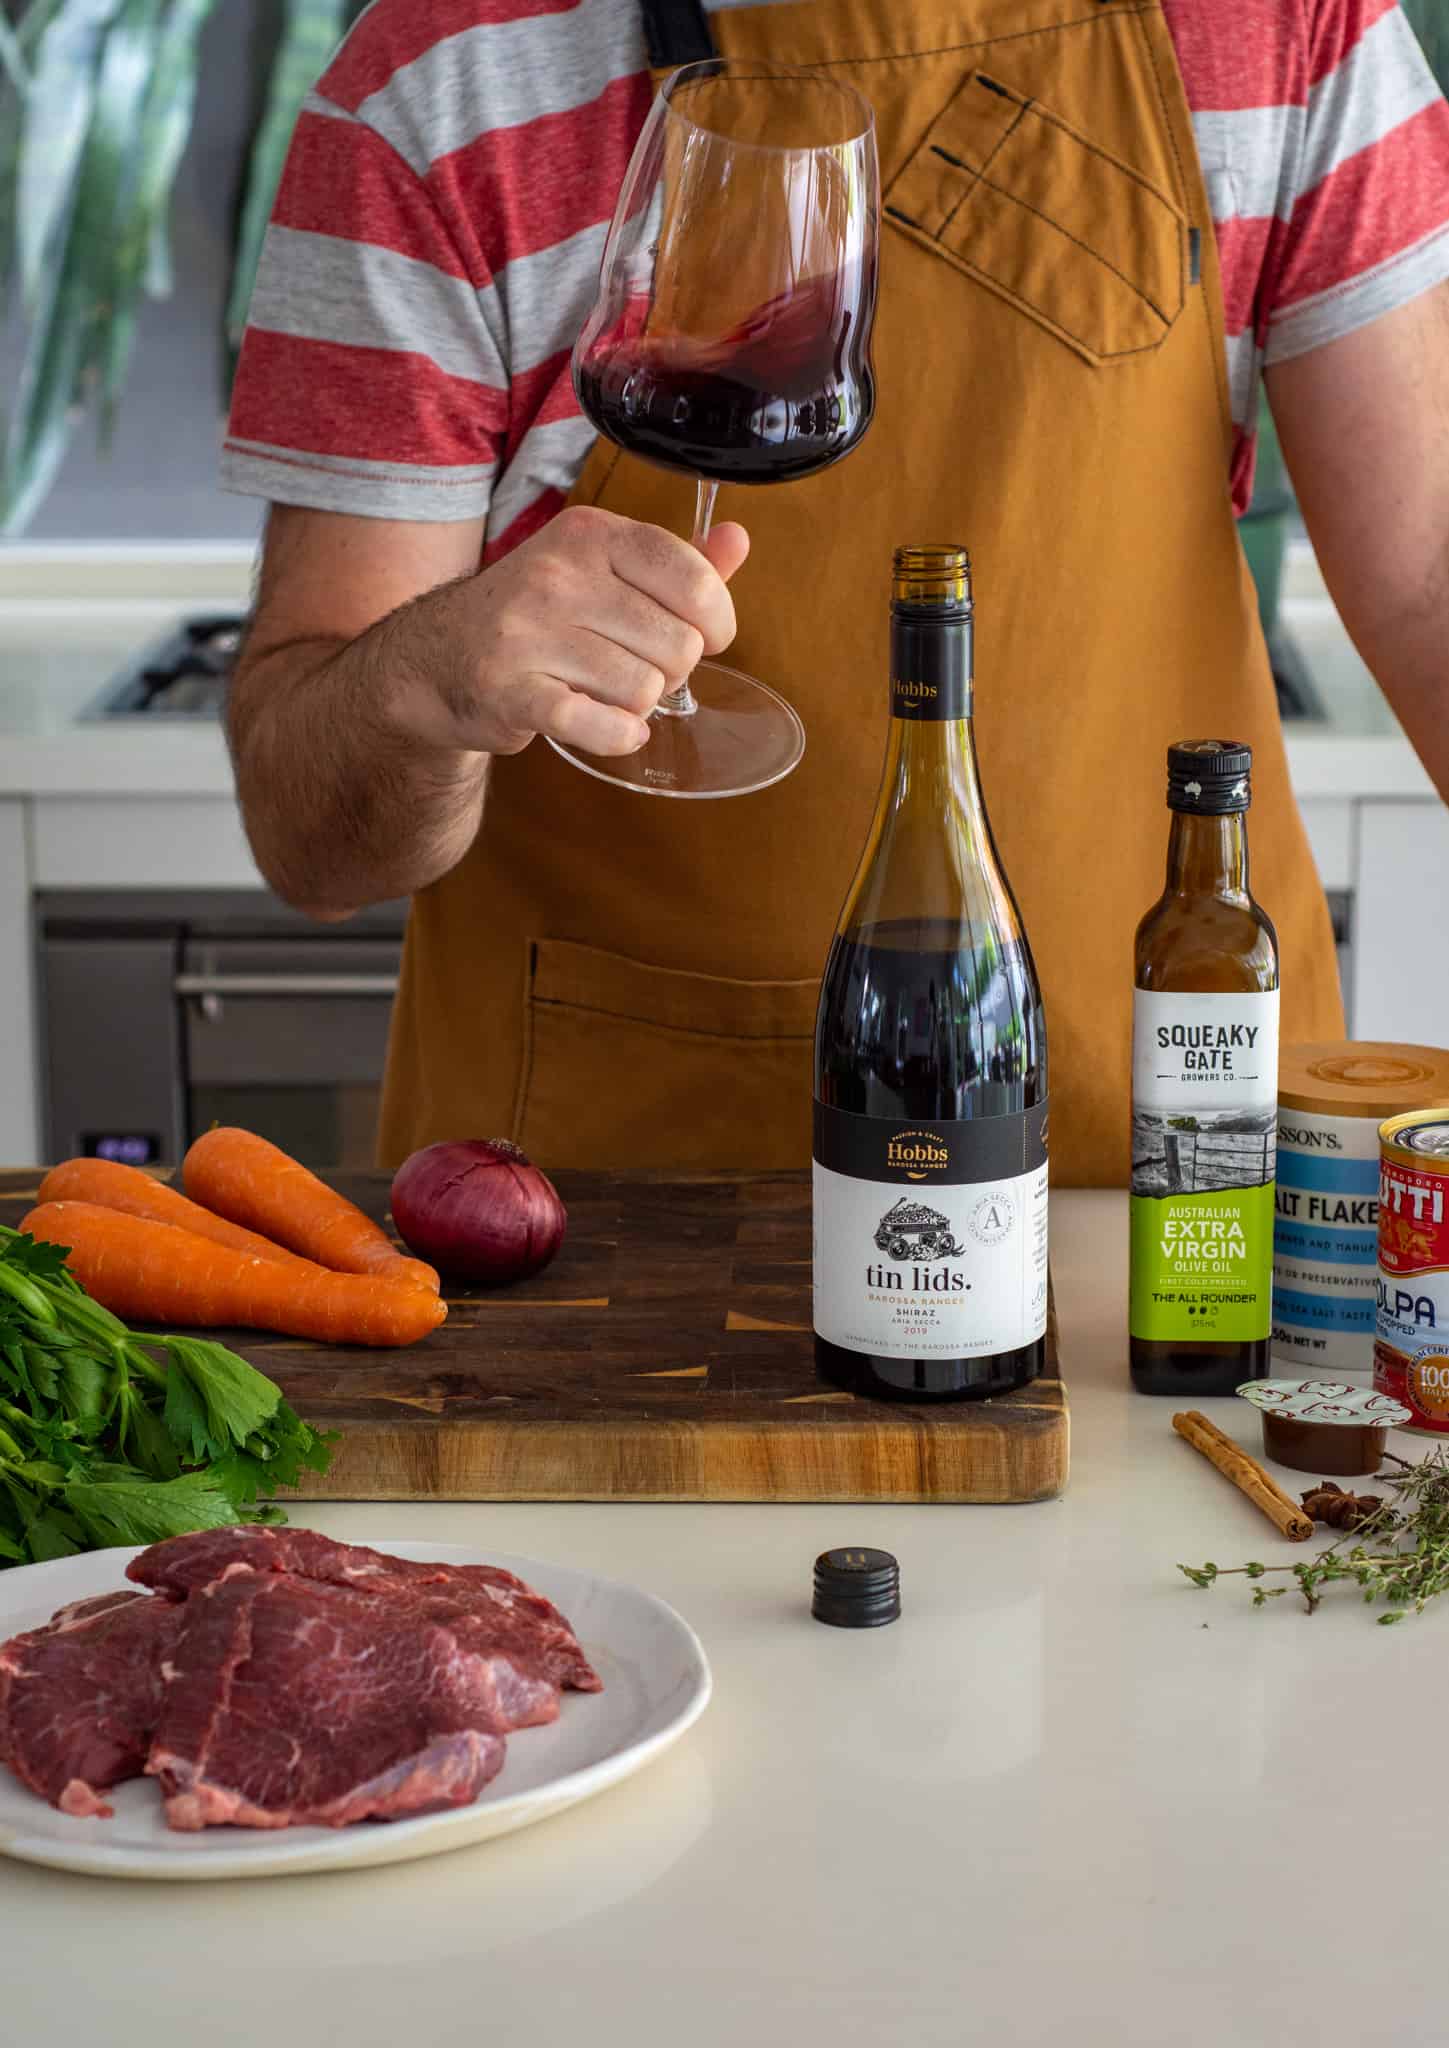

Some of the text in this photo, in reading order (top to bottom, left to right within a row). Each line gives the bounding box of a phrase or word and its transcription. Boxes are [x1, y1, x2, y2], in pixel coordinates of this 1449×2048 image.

[1156, 1024, 1259, 1049] SQUEAKY
[1184, 1050, 1233, 1070] GATE
[1277, 1125, 1338, 1150] SSON'S
[887, 1142, 948, 1161] Hobbs
[1379, 1172, 1444, 1224] UTTI
[984, 1205, 1001, 1230] A
[1168, 1207, 1241, 1219] AUSTRALIAN
[1309, 1197, 1379, 1225] FLAKE
[1164, 1221, 1244, 1239] EXTRA
[1160, 1241, 1246, 1259] VIRGIN
[1335, 1242, 1378, 1253] MANUF
[1174, 1261, 1232, 1273] OLIVE OIL
[867, 1264, 972, 1292] tin lids.
[1301, 1272, 1378, 1288] PRESERVATIVE
[868, 1294, 965, 1306] BAROSSA RANGES
[1152, 1293, 1257, 1303] THE ALL ROUNDER
[1376, 1278, 1436, 1328] OLPA
[896, 1308, 936, 1317] SHIRAZ
[904, 1327, 928, 1335] 2019
[1271, 1326, 1327, 1350] 50g NET WT
[1421, 1365, 1449, 1390] 100
